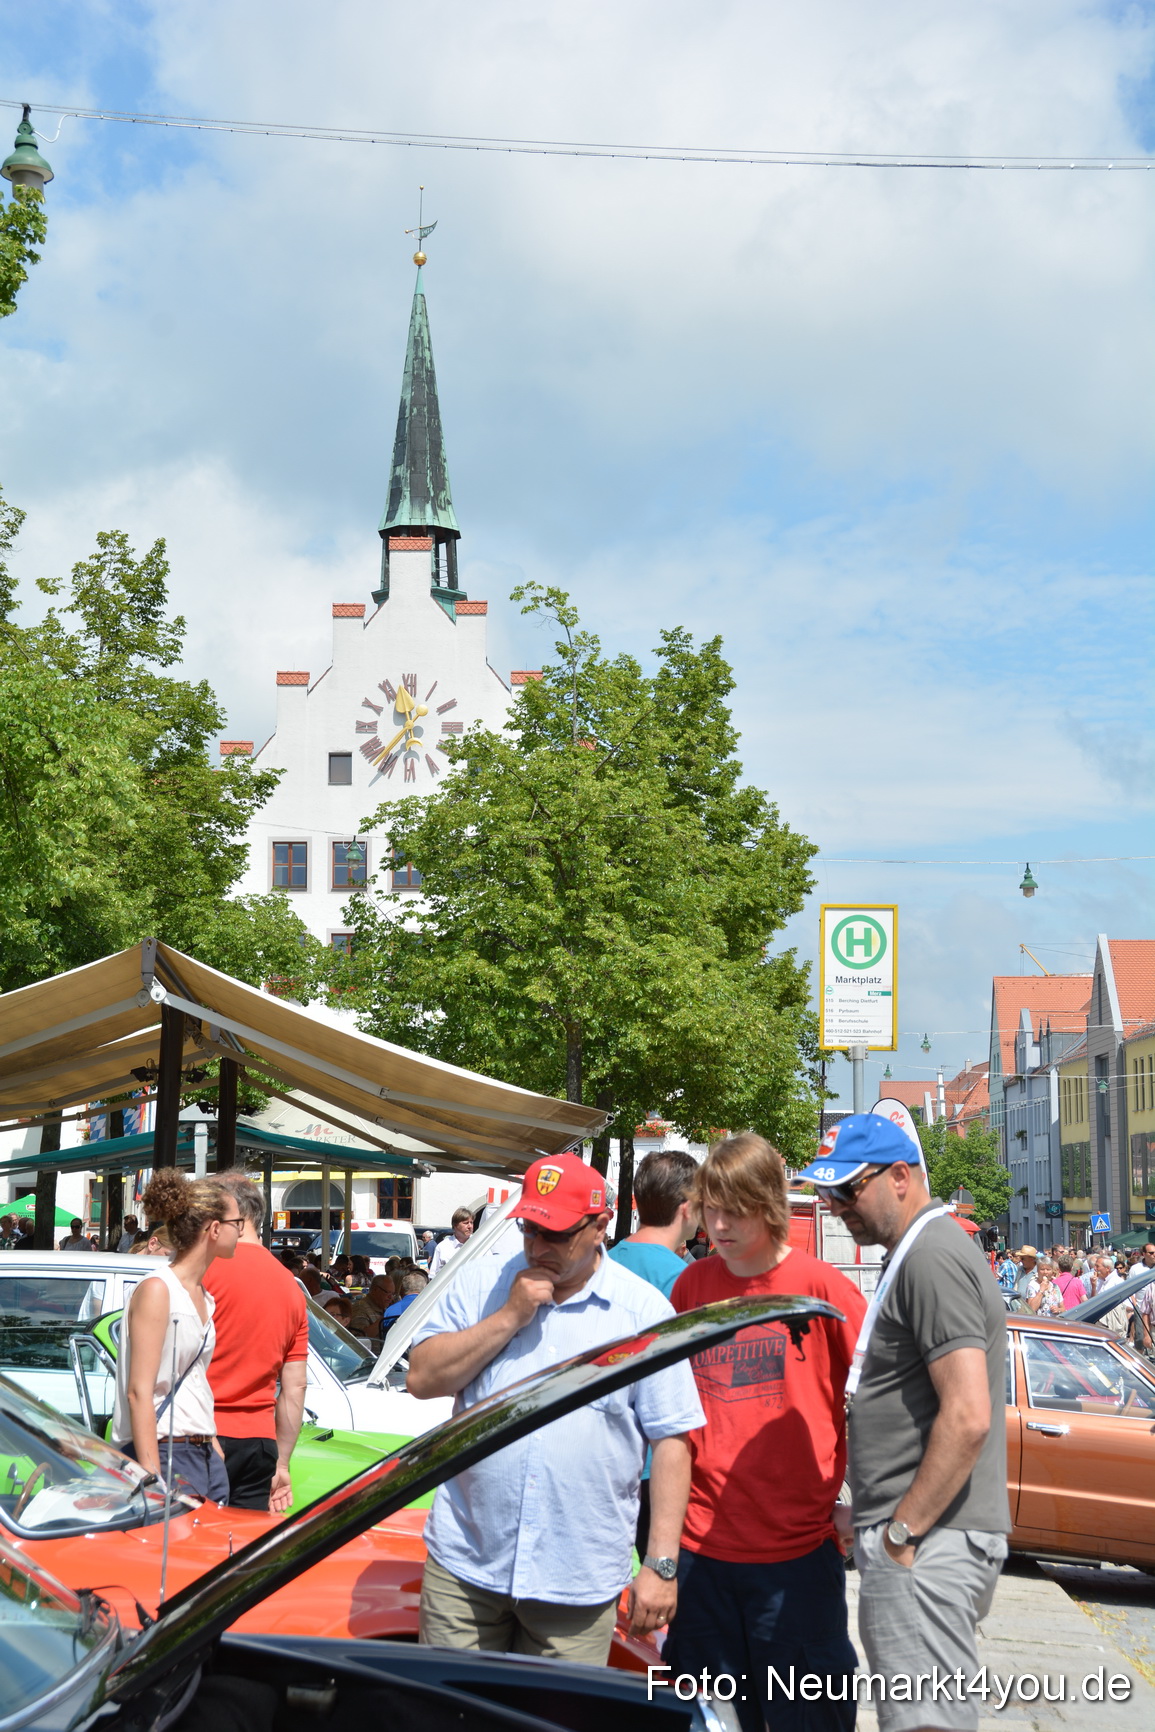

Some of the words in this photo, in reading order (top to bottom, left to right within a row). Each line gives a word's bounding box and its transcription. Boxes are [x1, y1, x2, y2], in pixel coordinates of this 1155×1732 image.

[846, 928, 872, 957] H
[835, 976, 882, 985] Marktplatz
[813, 1167, 836, 1181] 48
